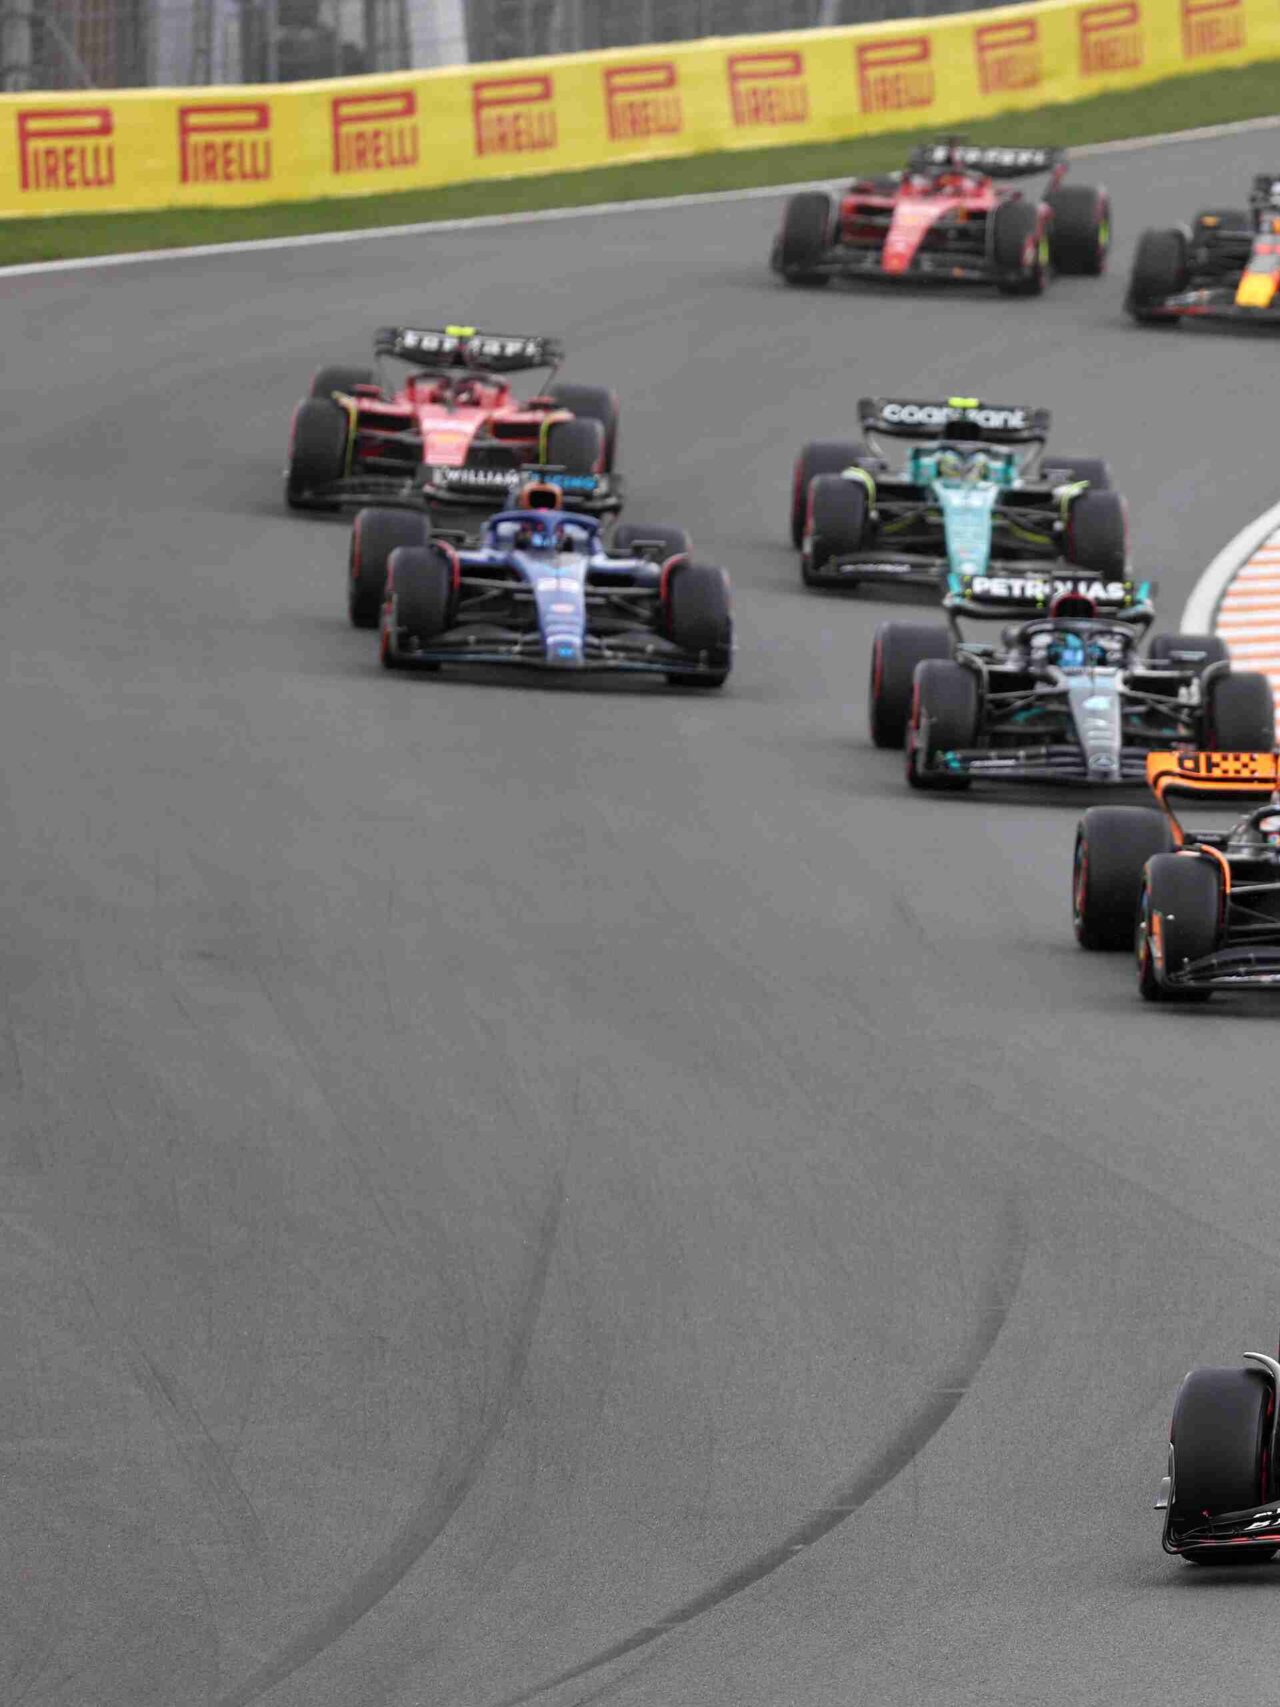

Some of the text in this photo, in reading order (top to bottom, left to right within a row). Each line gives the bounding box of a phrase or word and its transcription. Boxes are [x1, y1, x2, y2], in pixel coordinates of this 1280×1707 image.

[17, 107, 115, 192] PIRELLI
[179, 102, 271, 185] PIRELLI
[332, 90, 419, 174] PIRELLI
[472, 75, 557, 157] PIRELLI
[882, 403, 1025, 430] cognzant
[447, 469, 597, 490] WILLIAM RCING
